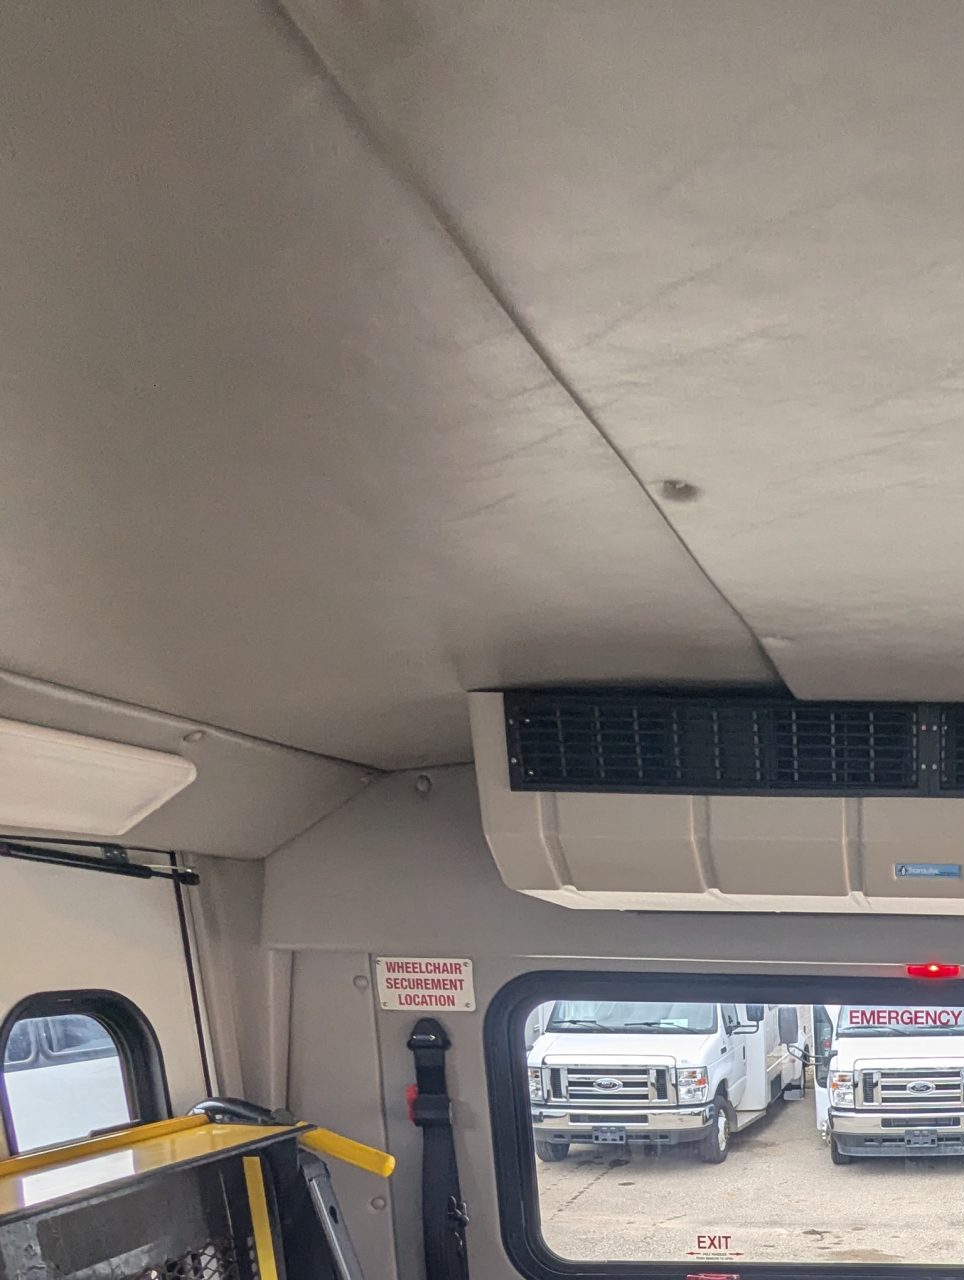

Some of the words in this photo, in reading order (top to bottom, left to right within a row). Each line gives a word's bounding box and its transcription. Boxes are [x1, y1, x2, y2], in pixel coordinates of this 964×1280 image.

[385, 962, 462, 975] WHEELCHAIR
[386, 978, 464, 990] SECUREMENT
[398, 994, 455, 1006] LOCATION
[850, 1010, 962, 1025] EMERGENCY
[697, 1235, 731, 1249] EXIT
